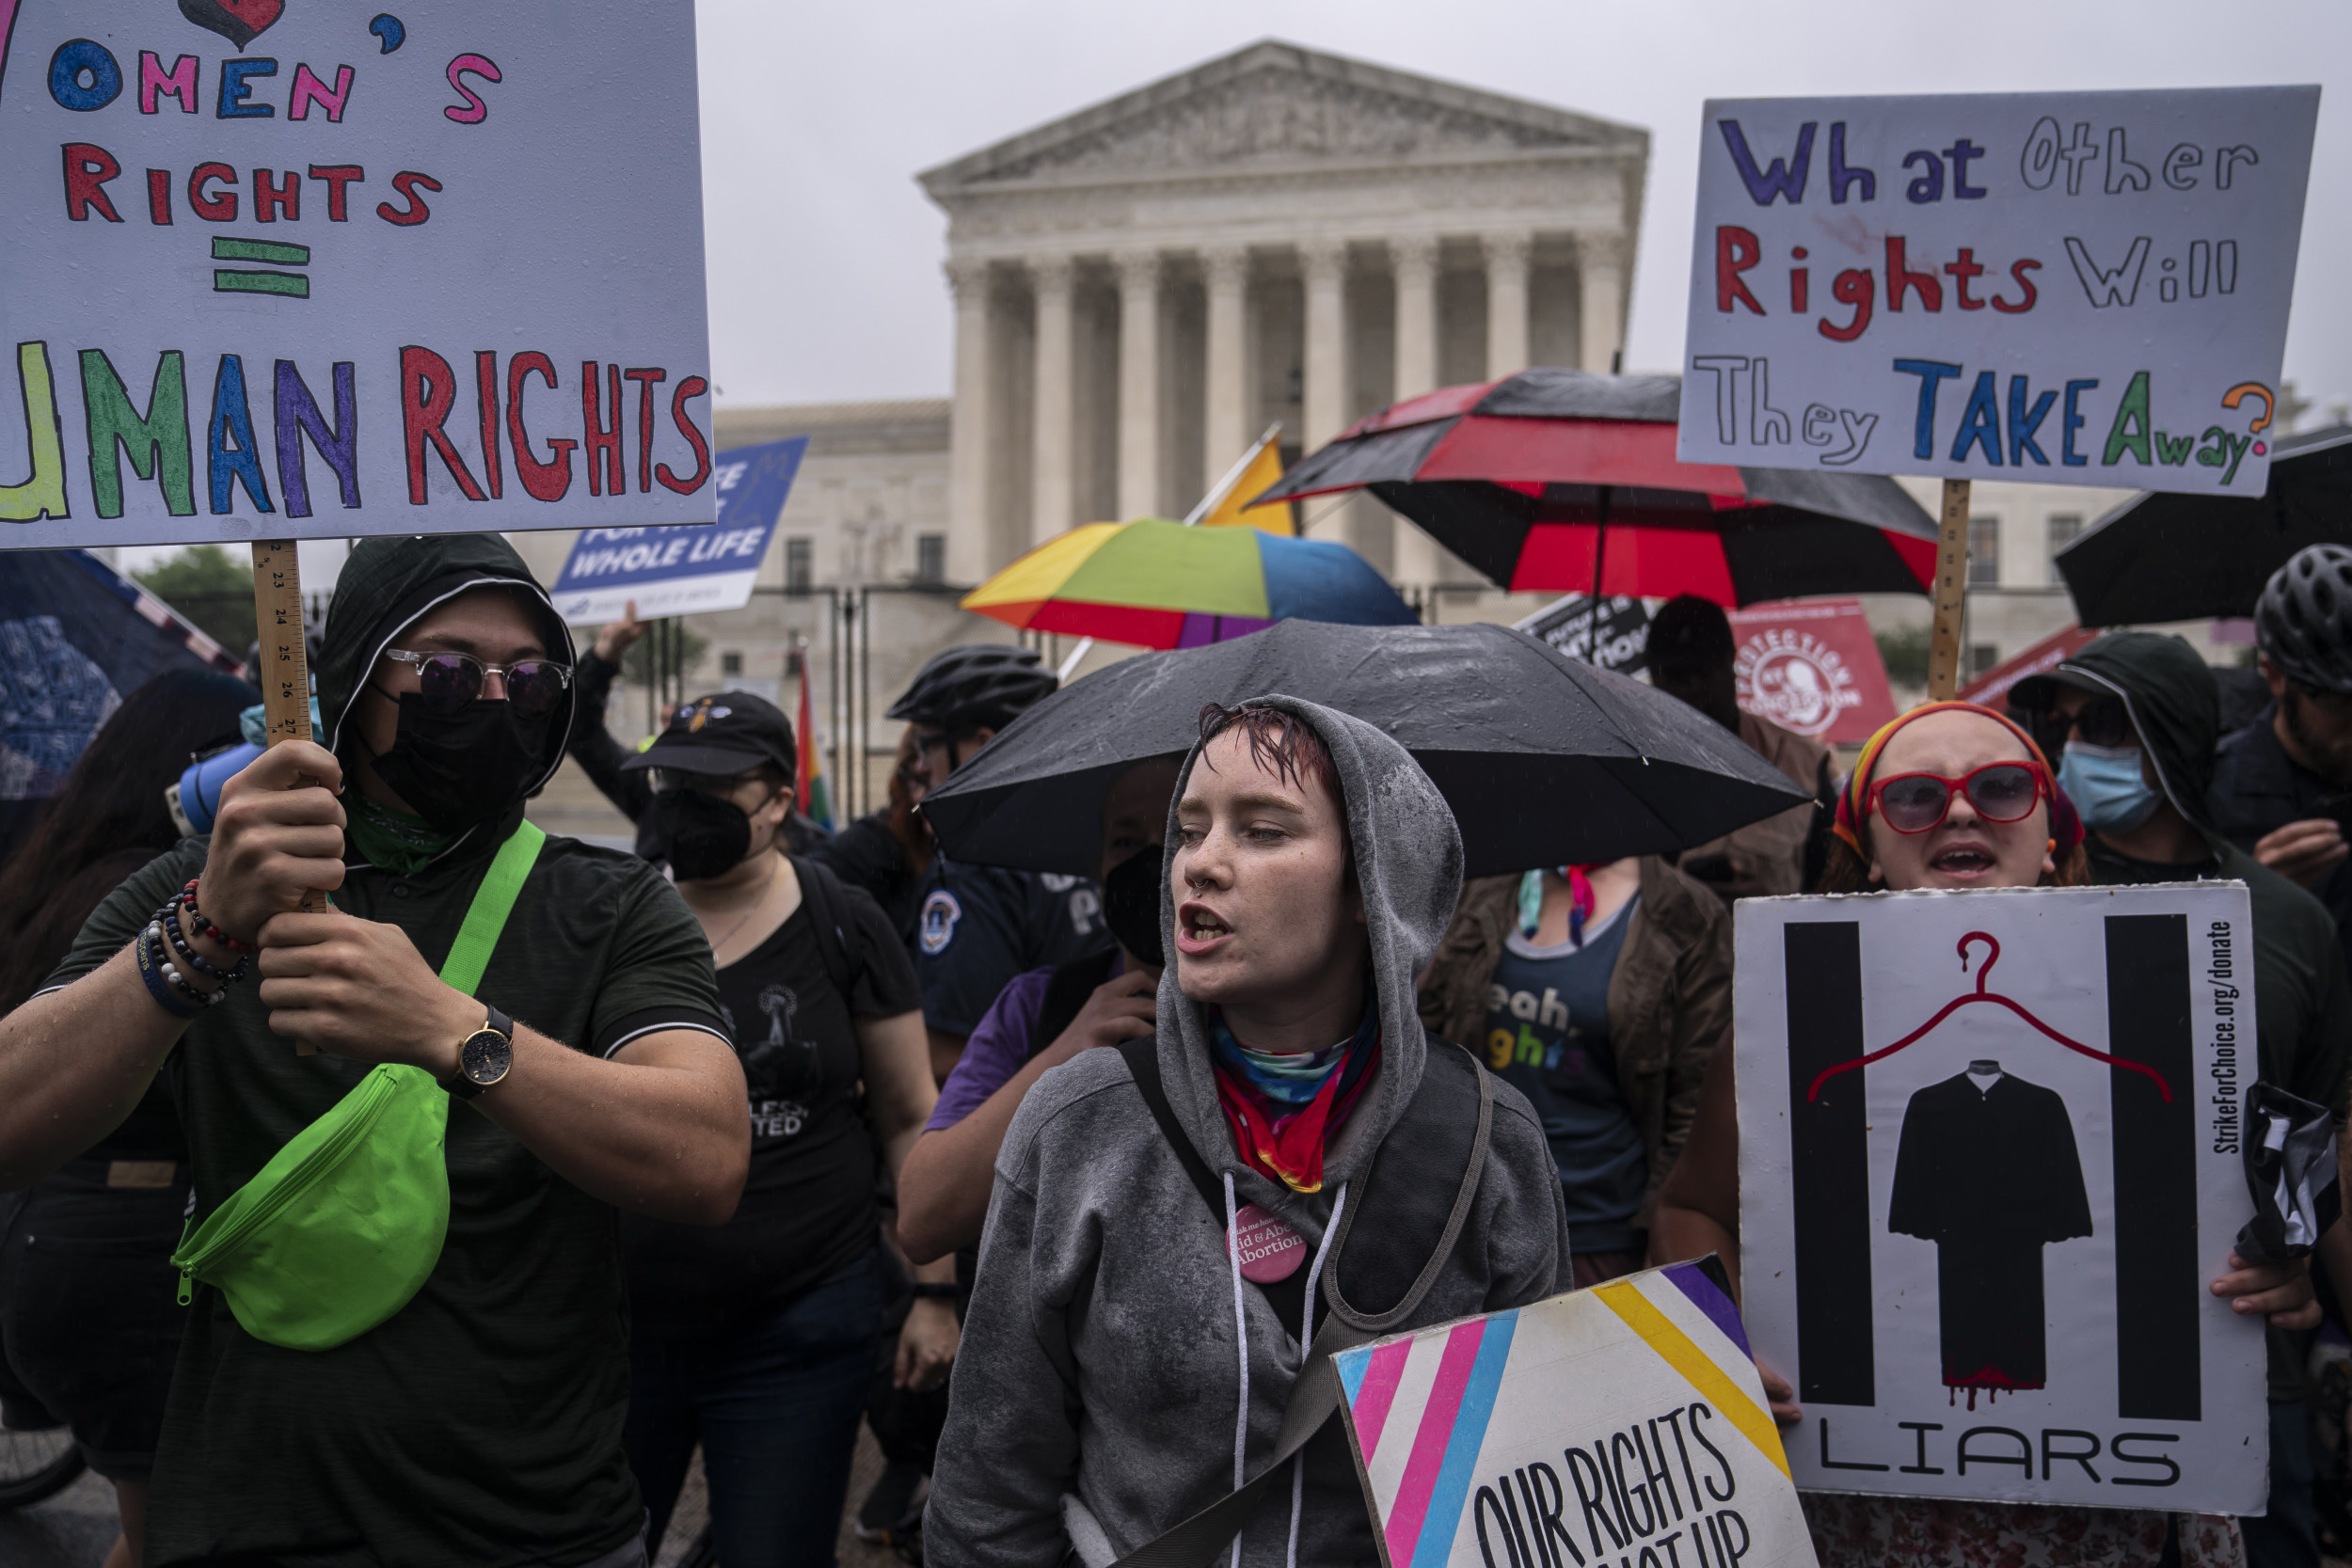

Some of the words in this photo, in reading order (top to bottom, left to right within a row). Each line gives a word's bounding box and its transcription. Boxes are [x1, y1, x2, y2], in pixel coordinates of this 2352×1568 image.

[0, 0, 501, 123] OMEN'S
[61, 143, 443, 226] RIGHTS
[1717, 119, 1988, 206] What
[2020, 116, 2258, 195] Other
[1716, 225, 2042, 341] Rights
[2064, 237, 2236, 309] Will
[399, 345, 712, 505] RIGHTS
[1693, 356, 1878, 466] They
[1893, 358, 2099, 467] TAKE
[273, 572, 285, 589] 23
[570, 536, 690, 579] WHOLE
[687, 525, 767, 563] LIFE
[276, 609, 287, 626] 24
[278, 645, 291, 661] 25
[282, 682, 294, 698] 26
[285, 718, 296, 735] 27
[1488, 1022, 1585, 1076] ghts
[2207, 921, 2240, 1154] StrikeForChoice.org/donate
[752, 1116, 802, 1137] TED
[1238, 1234, 1253, 1251] id
[1254, 1232, 1263, 1243] &
[1264, 1223, 1292, 1240] Abe
[1820, 1418, 2181, 1488] LIARS
[1474, 1462, 1586, 1568] OUR
[1565, 1402, 1736, 1558] RIGHTS
